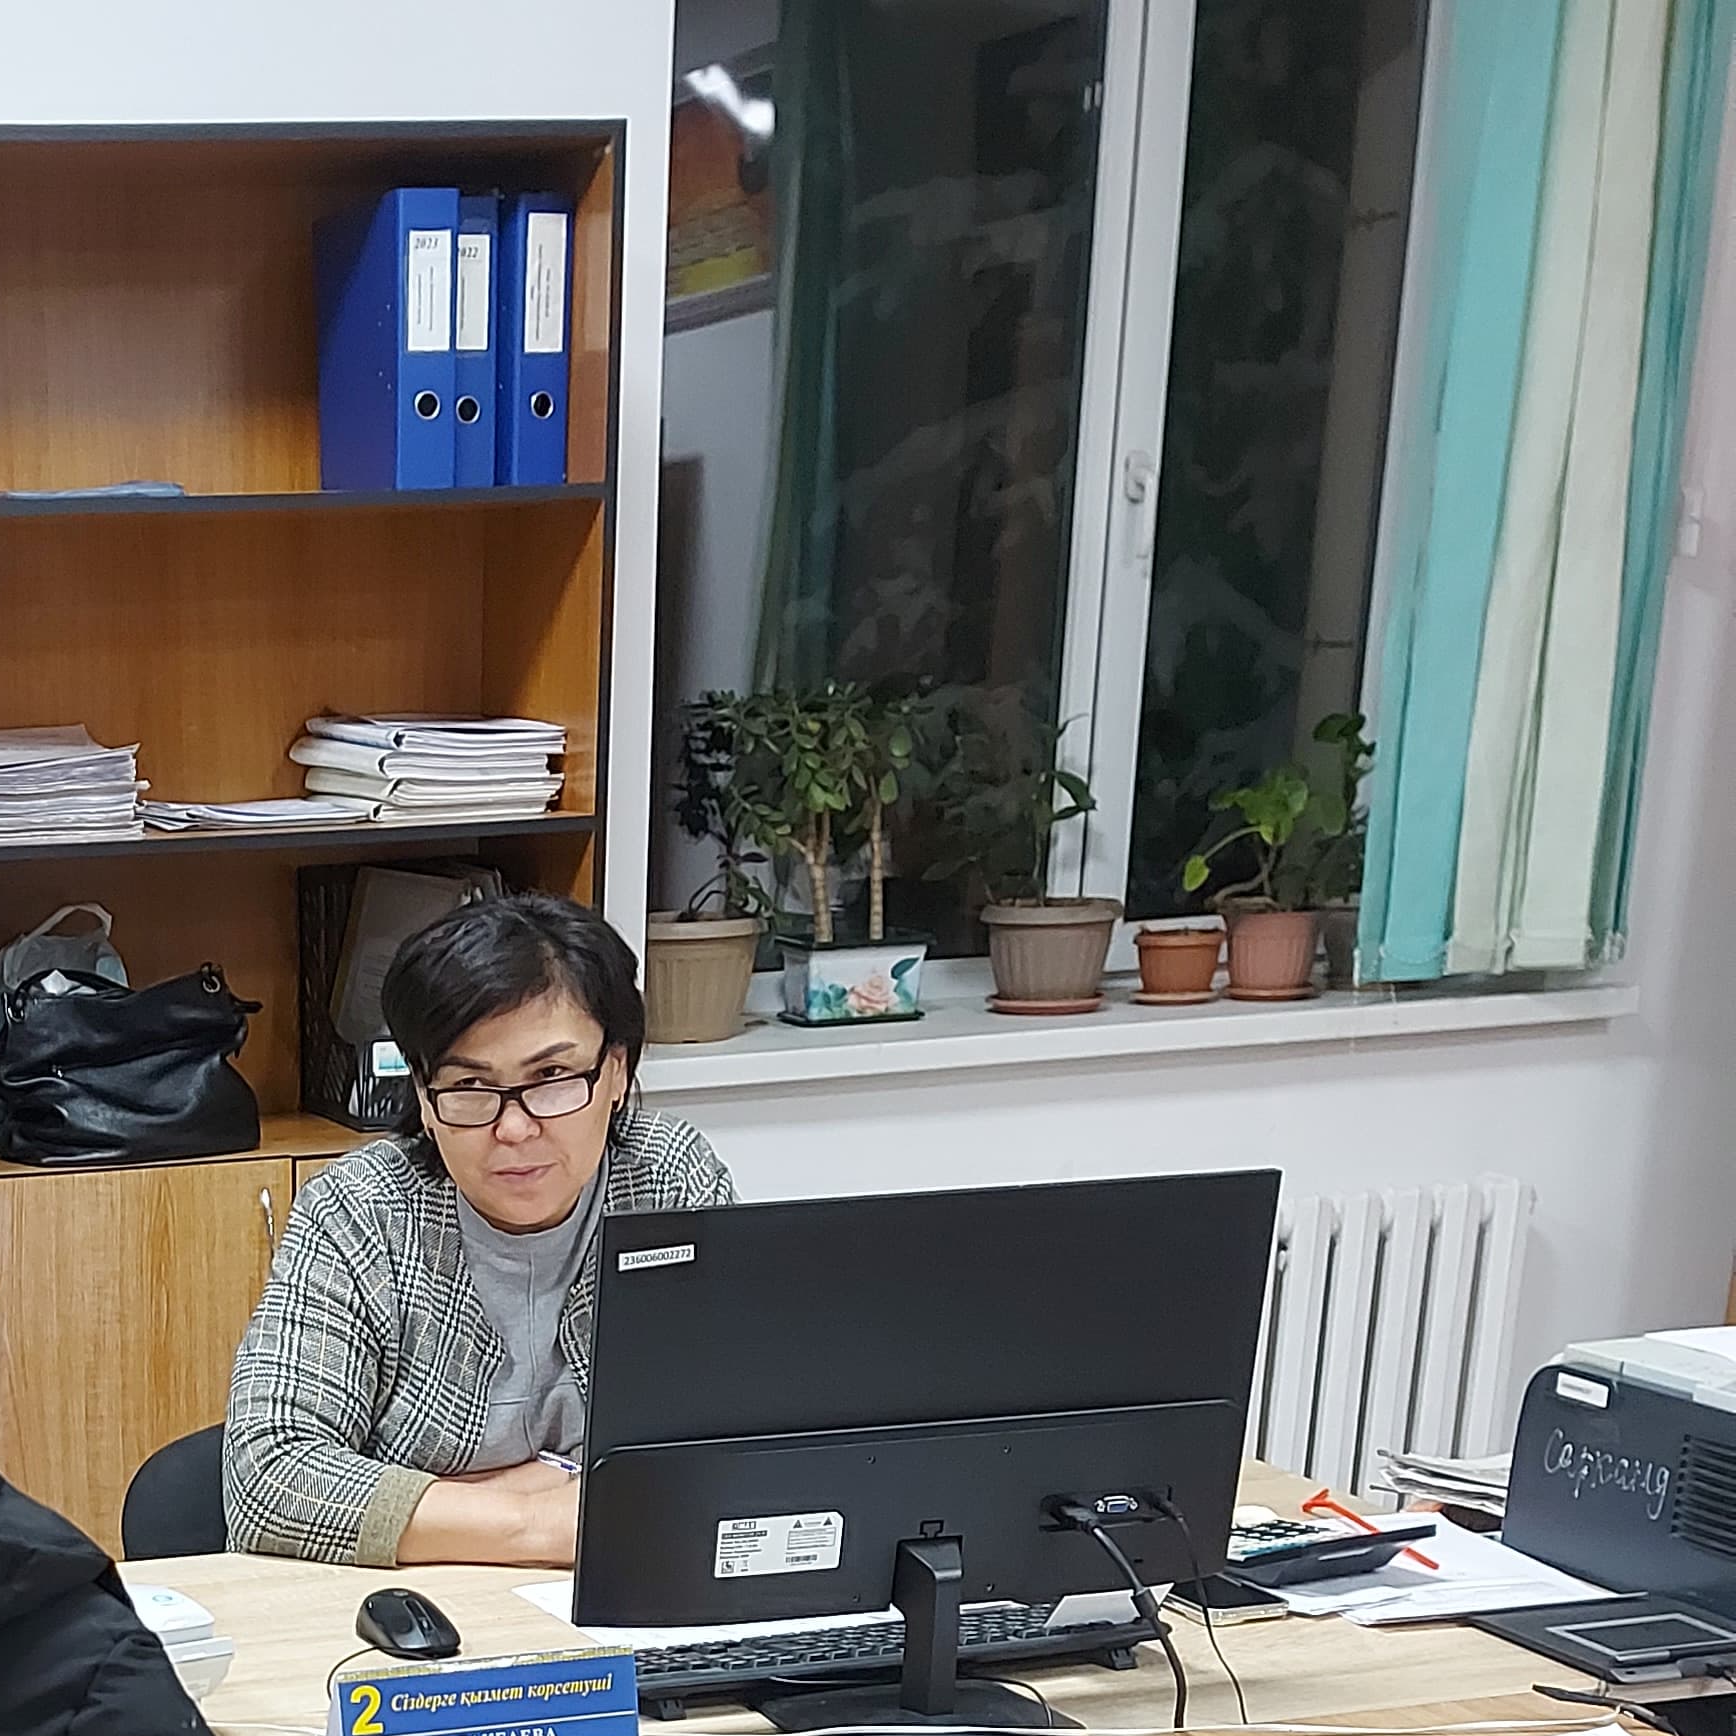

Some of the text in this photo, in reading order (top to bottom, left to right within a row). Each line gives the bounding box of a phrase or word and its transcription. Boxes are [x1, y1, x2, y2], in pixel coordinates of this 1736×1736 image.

[458, 246, 478, 258] 022
[350, 1684, 384, 1736] 2
[391, 1691, 457, 1713] Сіздерге
